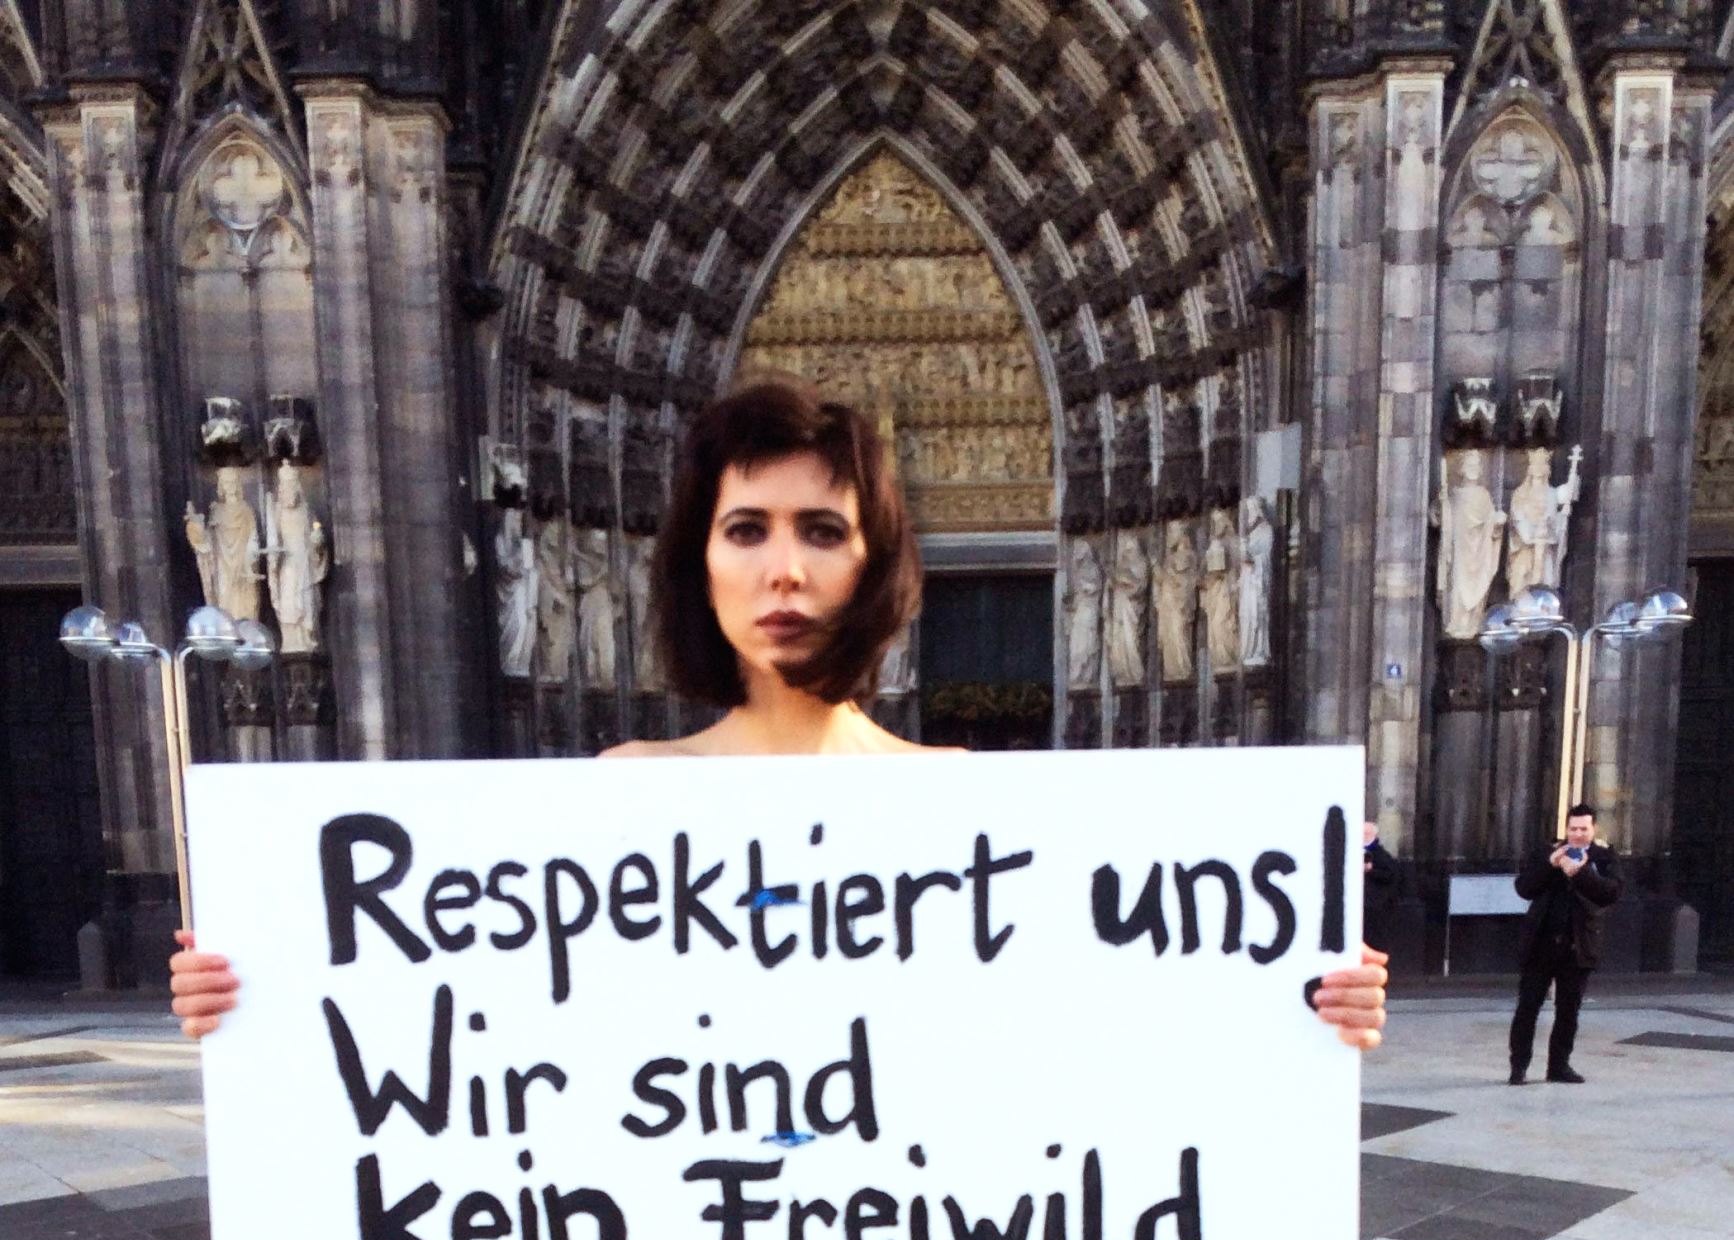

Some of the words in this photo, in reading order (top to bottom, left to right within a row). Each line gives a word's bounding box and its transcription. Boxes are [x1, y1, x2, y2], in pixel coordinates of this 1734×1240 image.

[320, 814, 1033, 1005] Respektiert
[1091, 805, 1347, 1012] uns!
[322, 983, 568, 1138] Wir
[620, 1016, 880, 1147] sind
